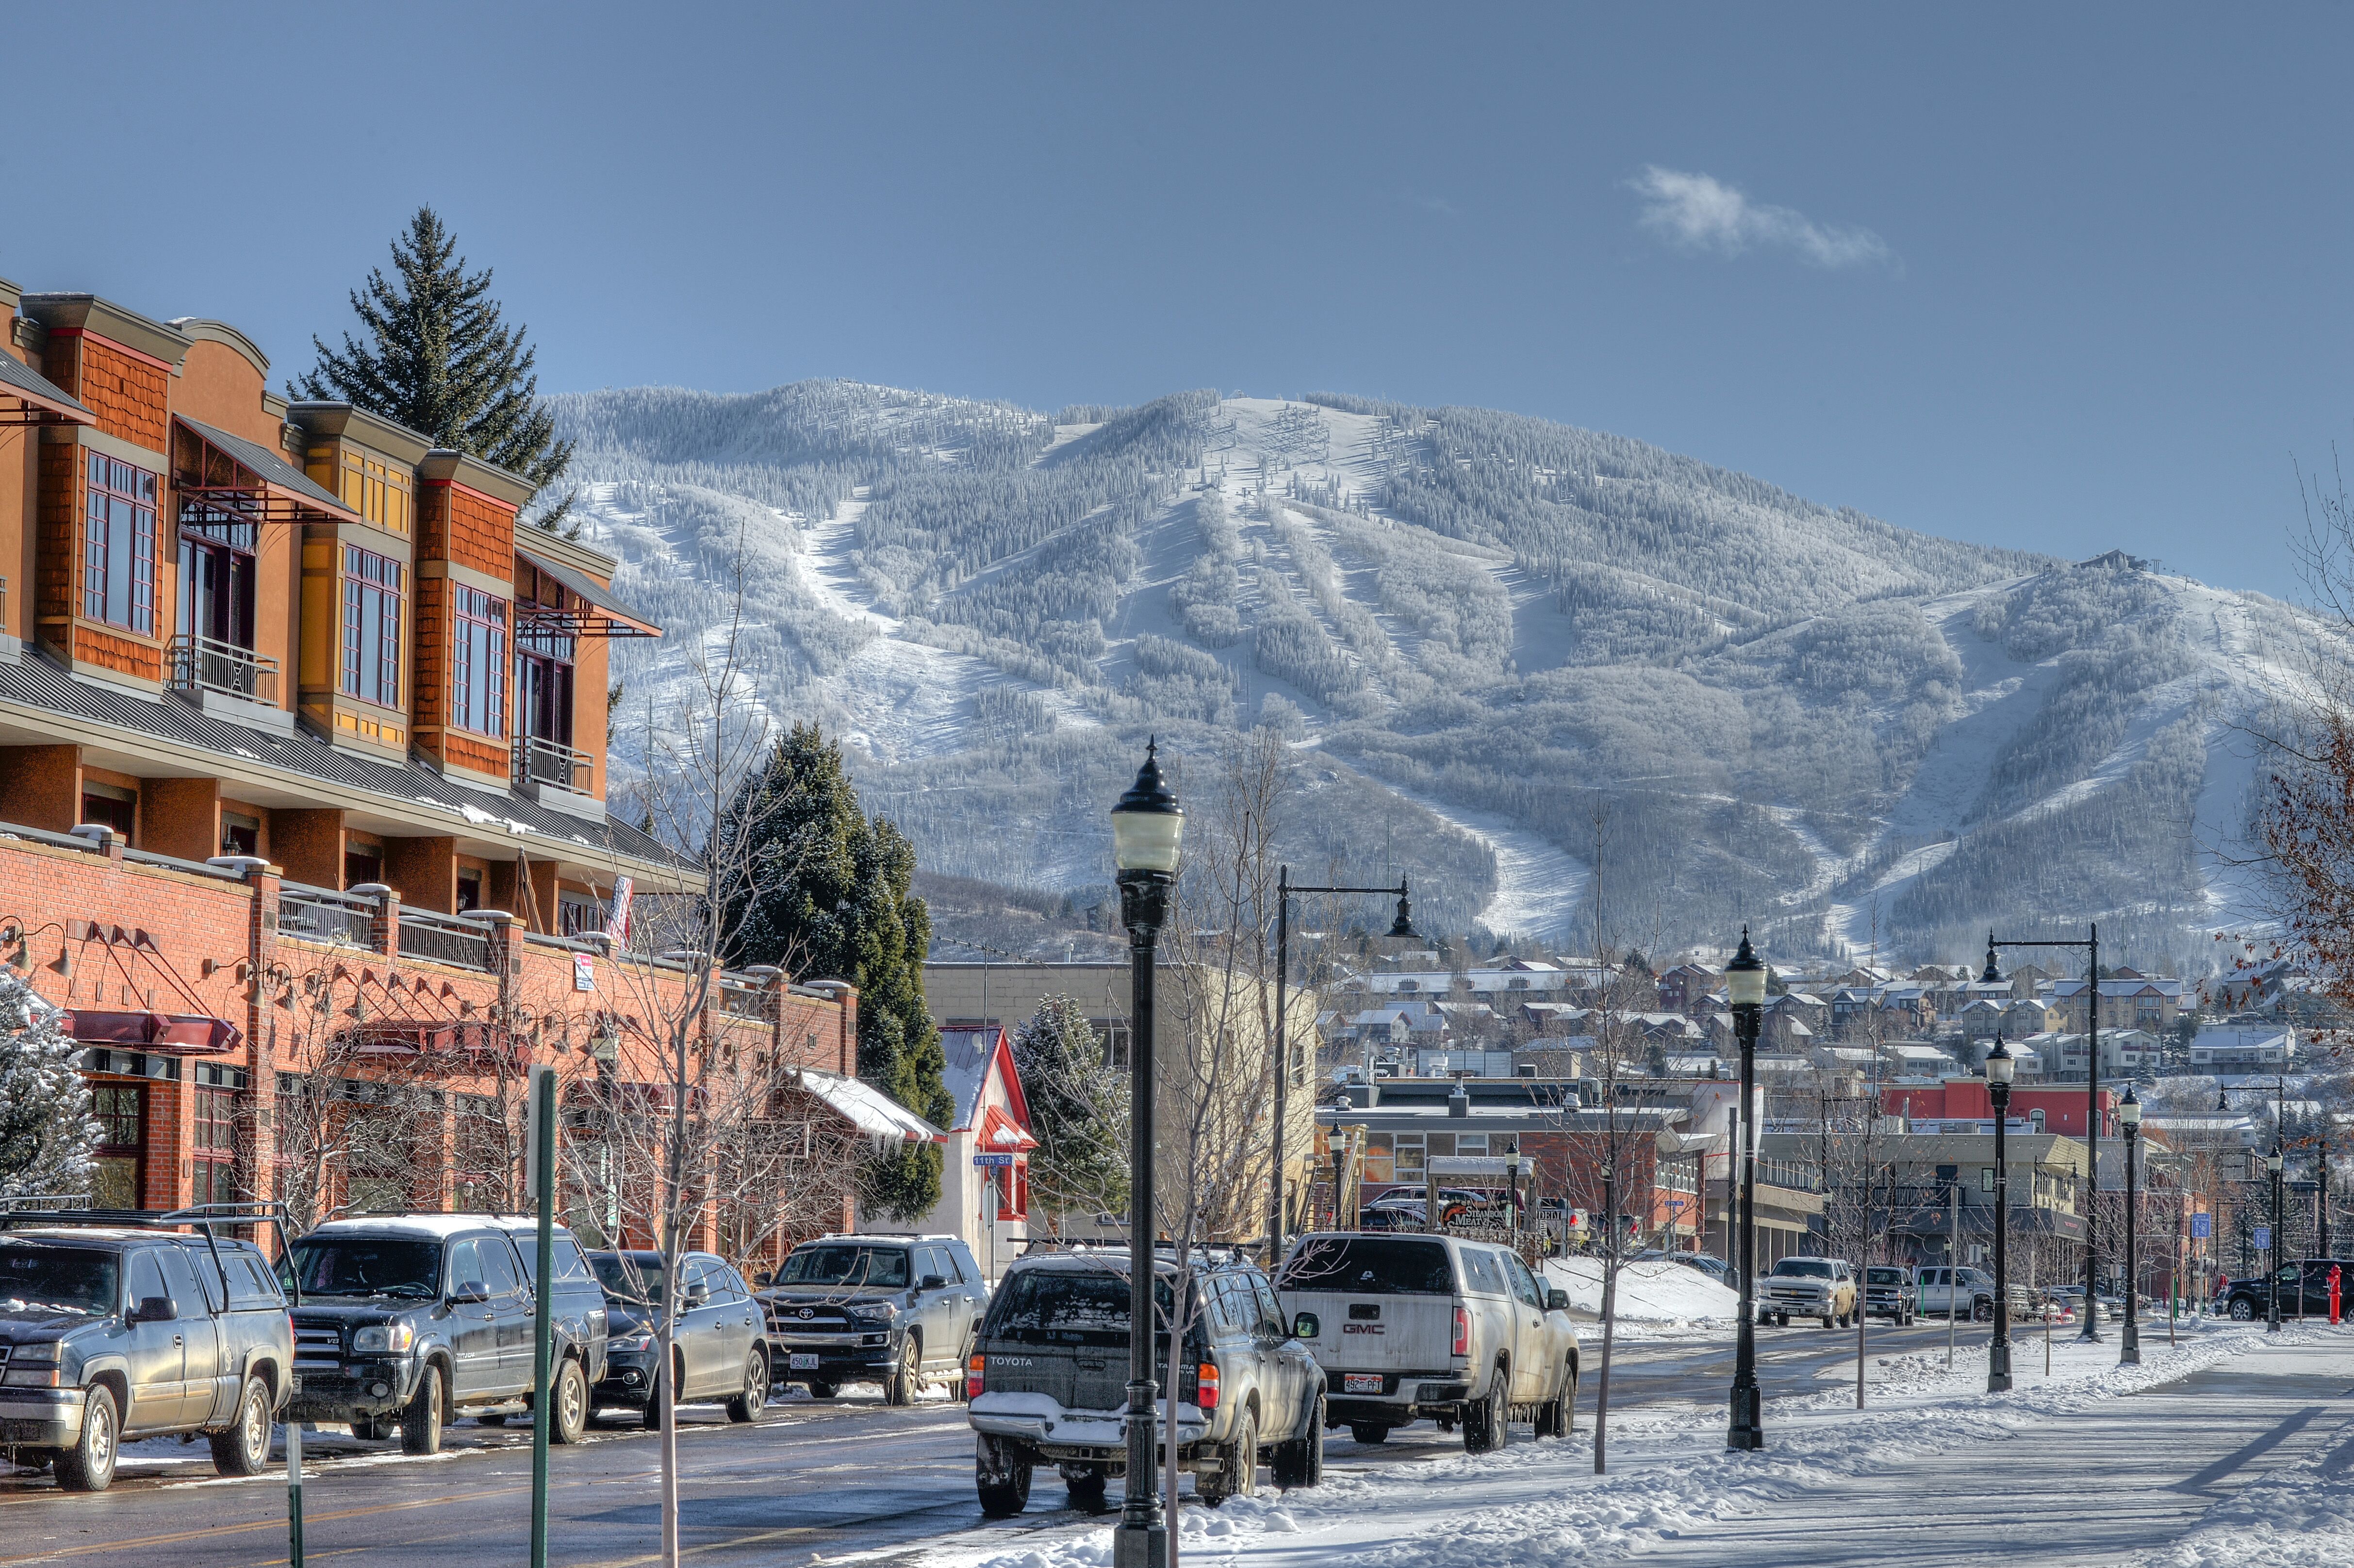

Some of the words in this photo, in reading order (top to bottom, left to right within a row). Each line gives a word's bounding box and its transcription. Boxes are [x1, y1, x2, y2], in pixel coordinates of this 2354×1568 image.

[1466, 1206, 1506, 1218] STEAMBOAT
[1538, 1211, 1560, 1220] DELI
[1455, 1214, 1480, 1226] MEAT
[1343, 1324, 1385, 1335] GMC
[991, 1357, 1032, 1366] TOYOTA
[1347, 1380, 1359, 1389] 492
[1368, 1380, 1380, 1389] PFT
